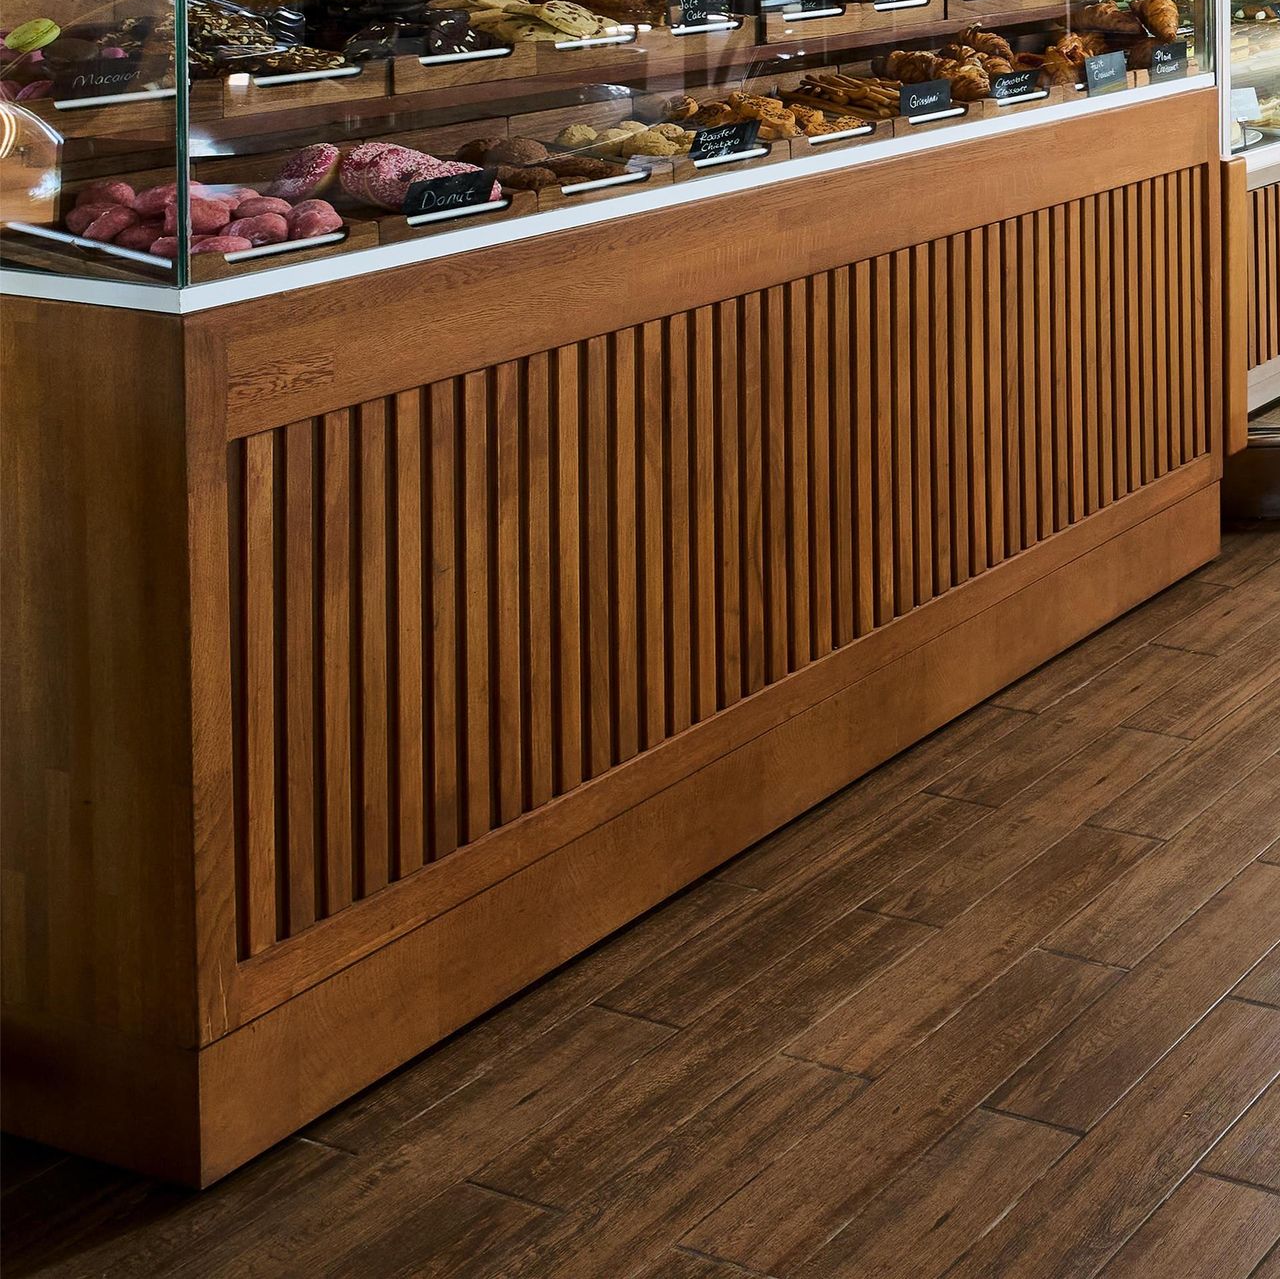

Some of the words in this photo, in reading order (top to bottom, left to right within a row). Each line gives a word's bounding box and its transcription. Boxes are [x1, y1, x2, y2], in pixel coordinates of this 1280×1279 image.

[686, 10, 707, 21] Cake
[699, 126, 737, 144] Roasted
[420, 187, 475, 210] Donut
